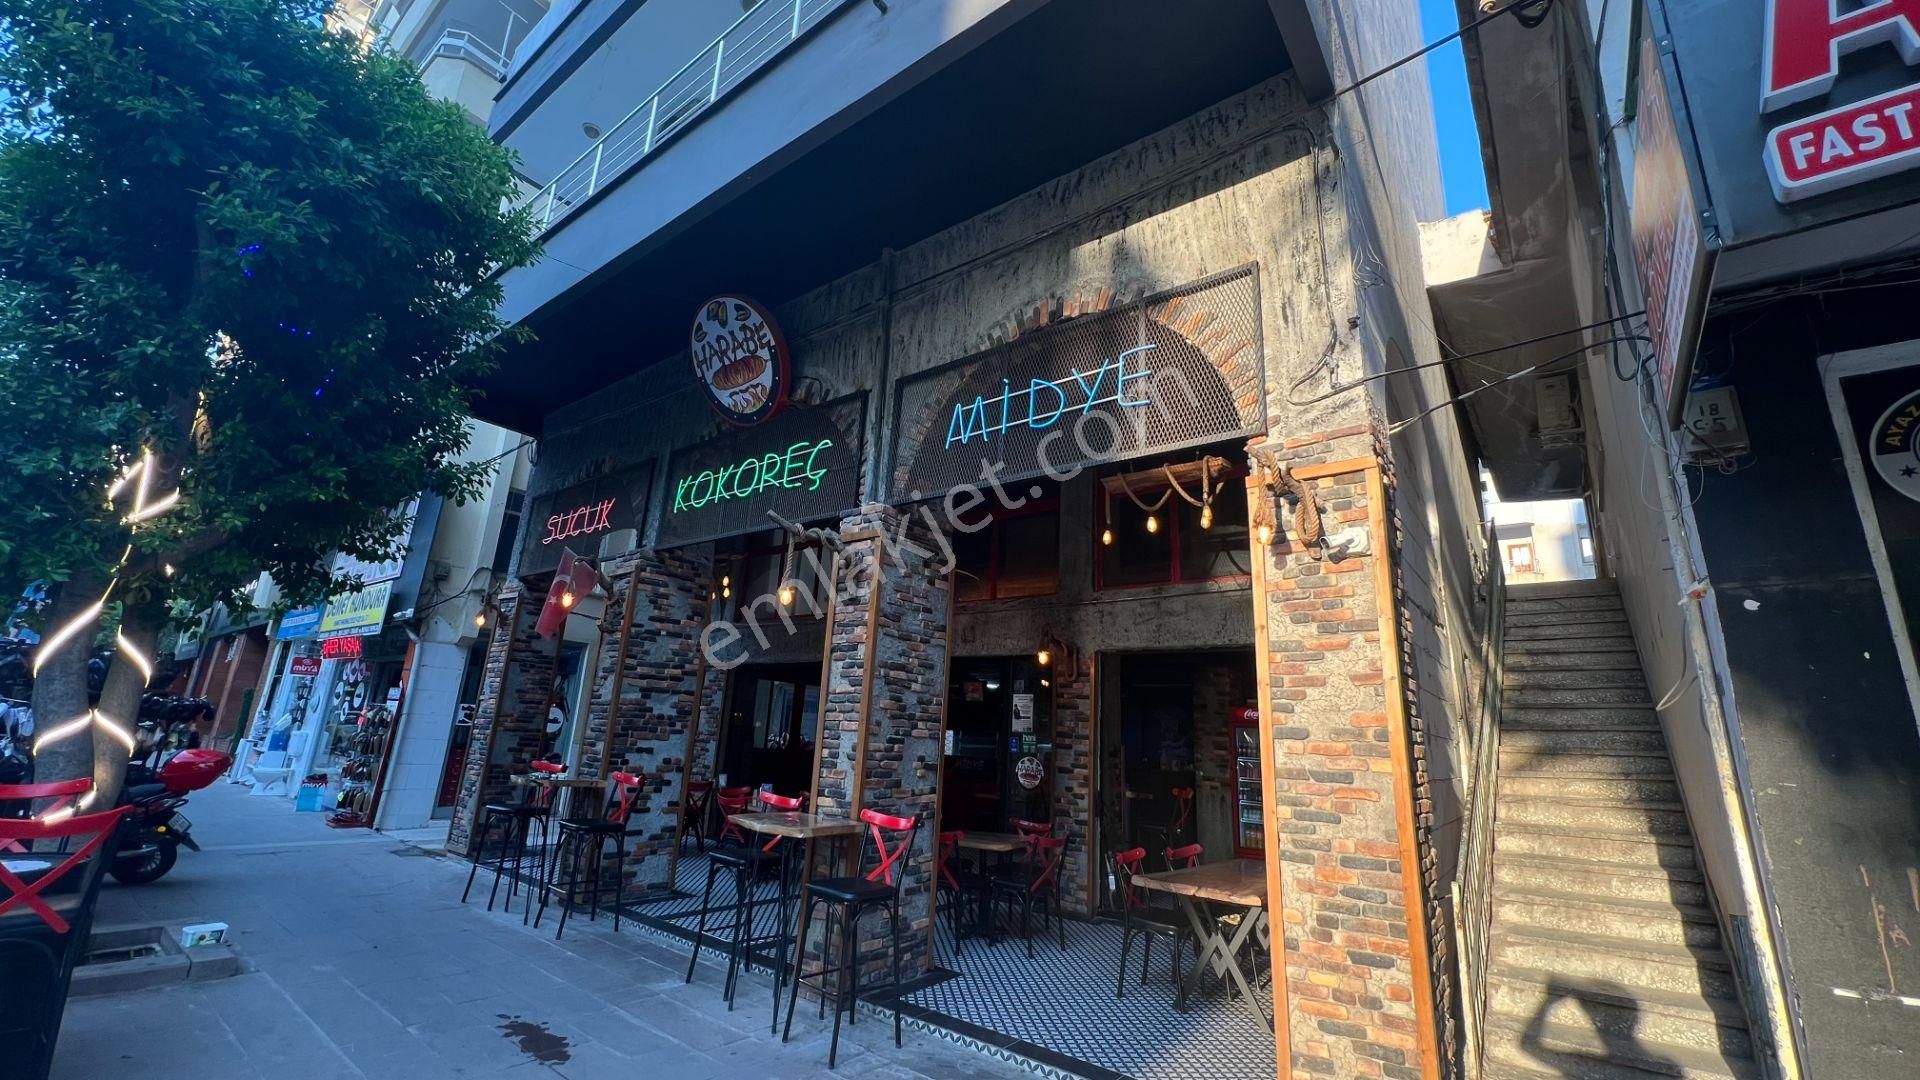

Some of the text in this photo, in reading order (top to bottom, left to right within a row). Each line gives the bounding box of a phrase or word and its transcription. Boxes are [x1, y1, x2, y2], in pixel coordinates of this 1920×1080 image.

[1789, 102, 1913, 170] FAST
[693, 320, 771, 374] HARABE
[945, 344, 1157, 449] MİDYE
[673, 439, 834, 514] KOKOREÇ
[542, 497, 616, 545] SUCUK
